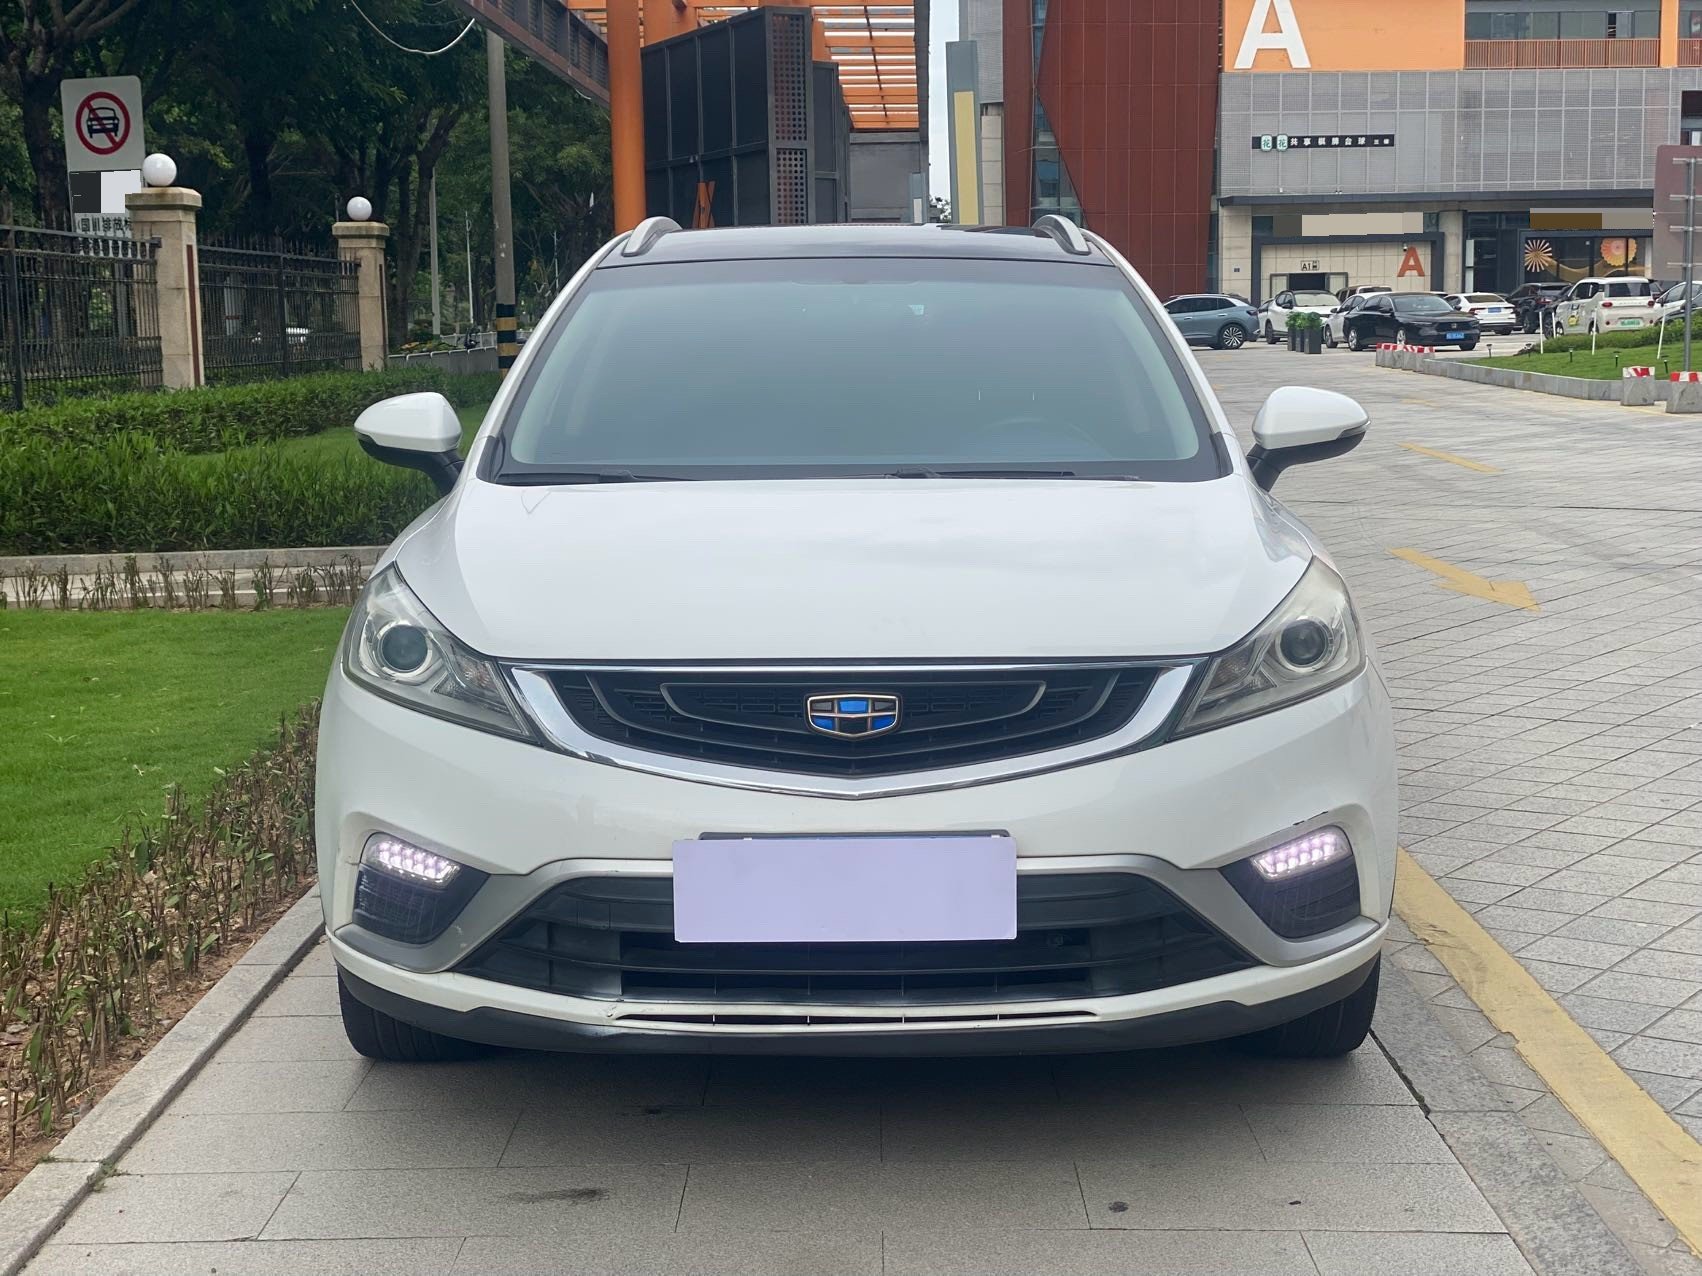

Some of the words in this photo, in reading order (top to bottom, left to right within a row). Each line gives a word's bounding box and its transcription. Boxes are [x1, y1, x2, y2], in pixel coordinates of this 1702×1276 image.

[1234, 0, 1311, 69] A
[1301, 262, 1311, 271] A1
[1397, 247, 1425, 277] A
